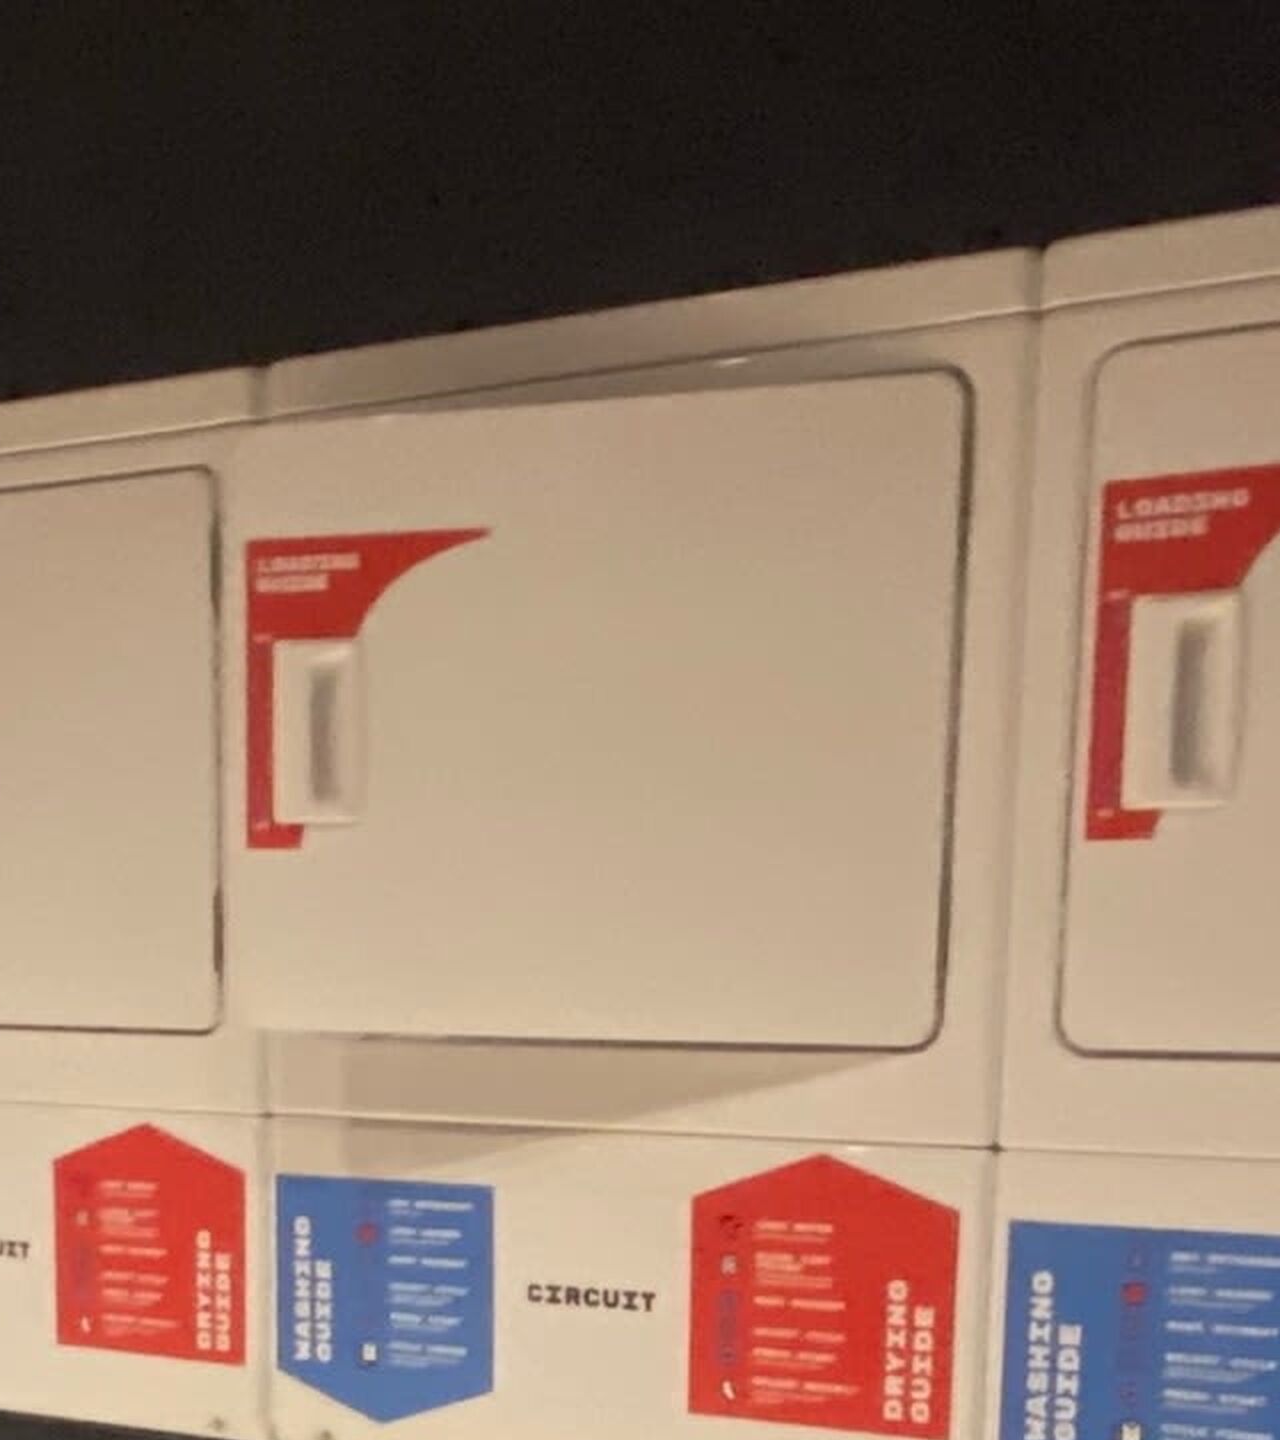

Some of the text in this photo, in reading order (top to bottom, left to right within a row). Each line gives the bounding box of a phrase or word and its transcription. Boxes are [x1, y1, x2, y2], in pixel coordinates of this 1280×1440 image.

[527, 1283, 657, 1312] CIRCUIT
[882, 1279, 909, 1421] DRYING
[910, 1305, 936, 1424] GUIDE
